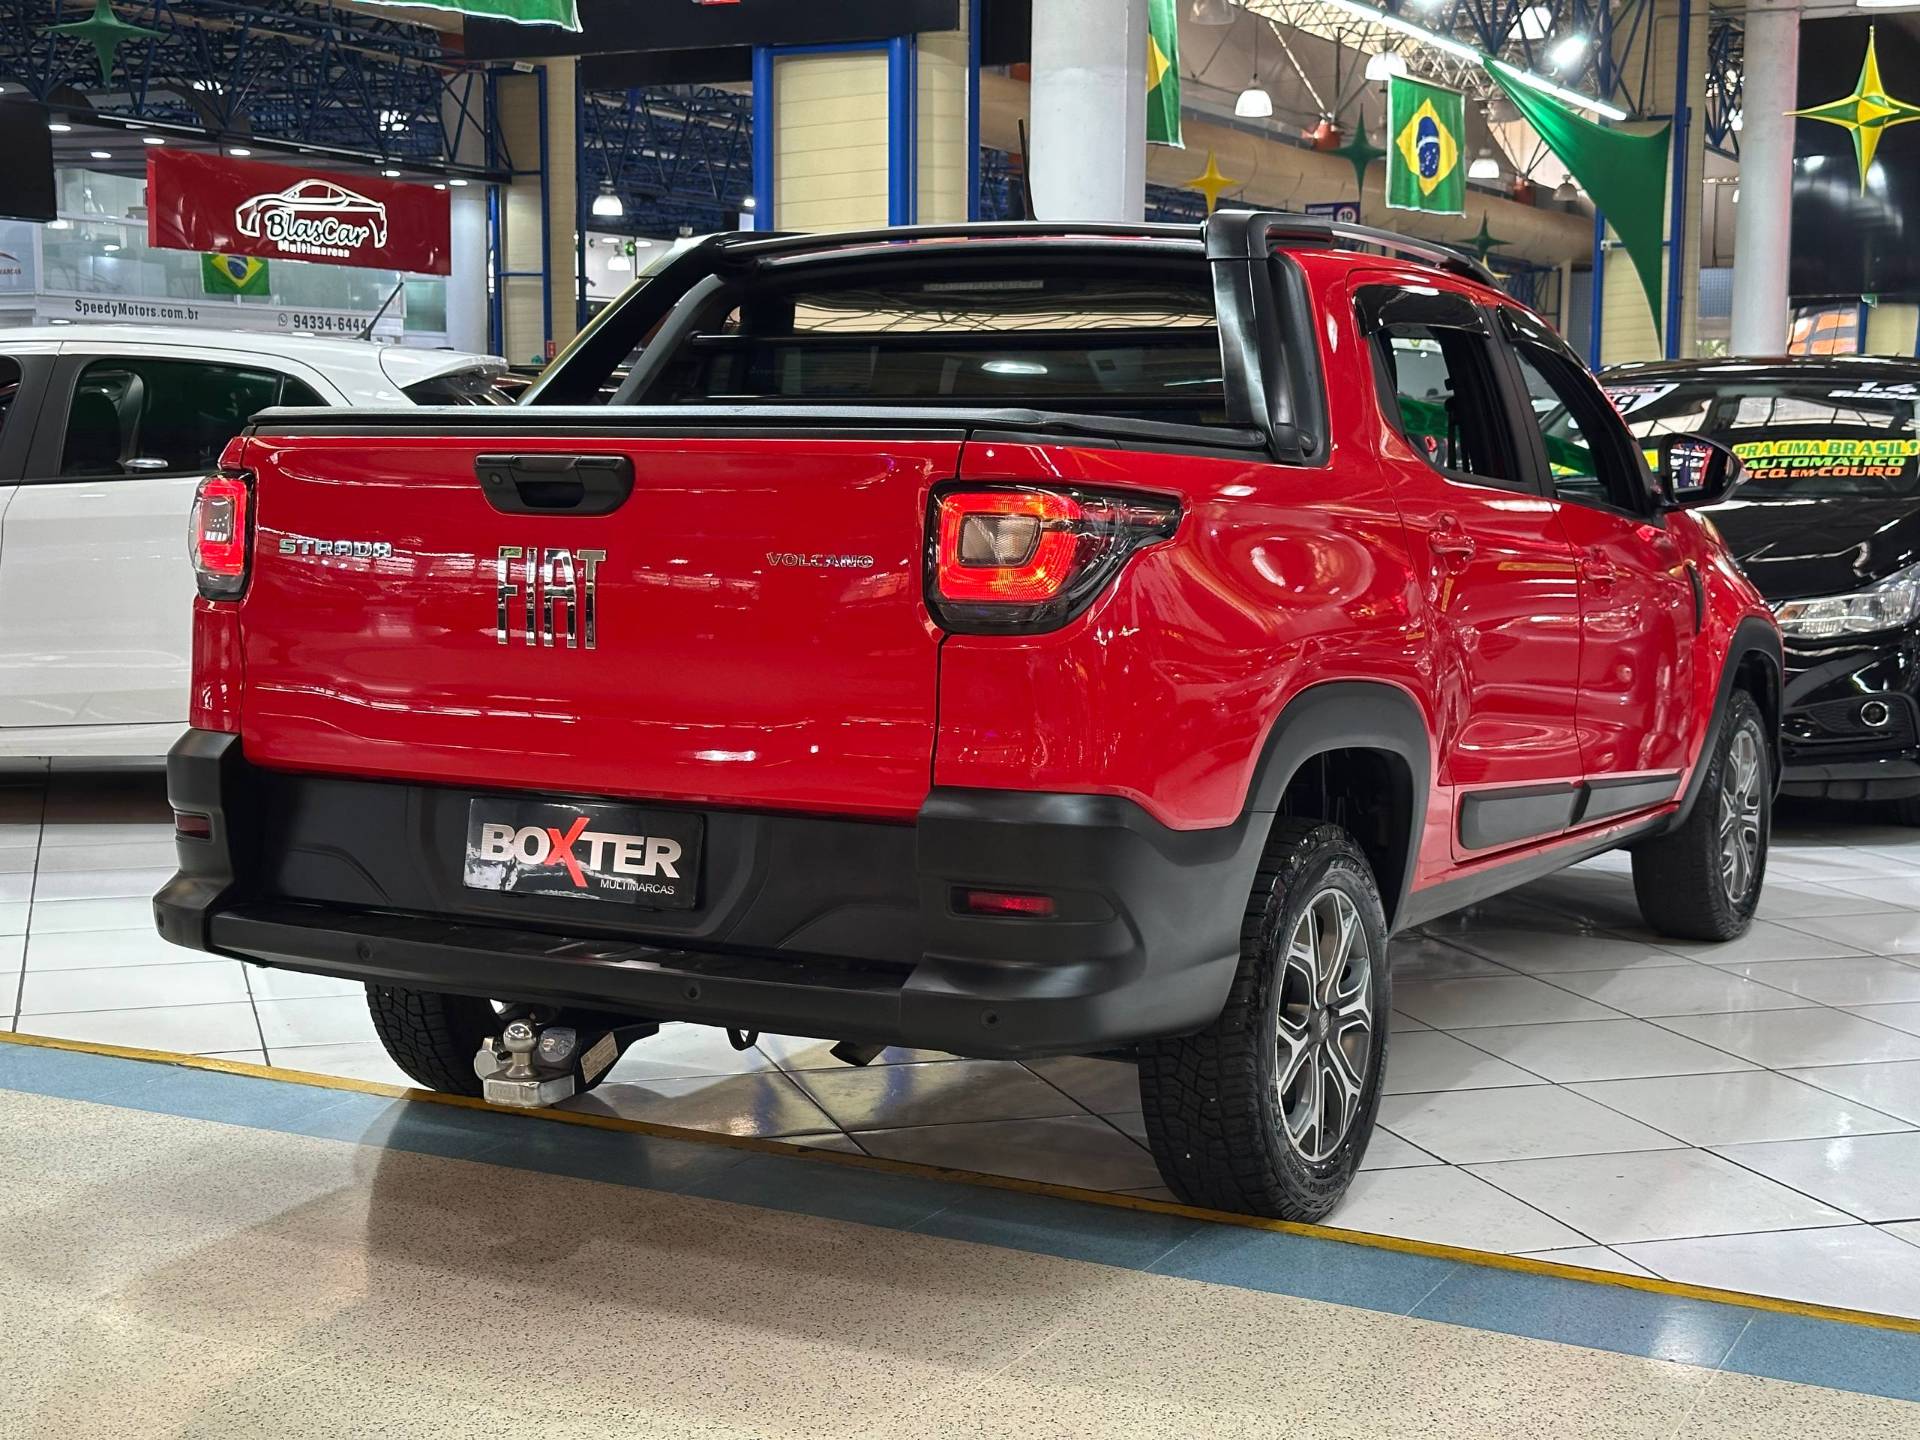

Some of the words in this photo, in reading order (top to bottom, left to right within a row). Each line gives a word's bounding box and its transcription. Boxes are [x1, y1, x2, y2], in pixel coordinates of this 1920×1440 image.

[264, 208, 370, 248] BlasCar
[74, 299, 199, 320] SpeedyMotors.com.br
[293, 314, 367, 332] 94334-6444
[1776, 440, 1822, 456] CIMA
[1817, 466, 1903, 477] COURO
[279, 537, 392, 558] STRADA
[765, 552, 875, 569] VOLCANO
[496, 545, 607, 650] FIAT
[480, 816, 682, 888] BOXTER
[599, 879, 676, 895] MULTIMARCAS
